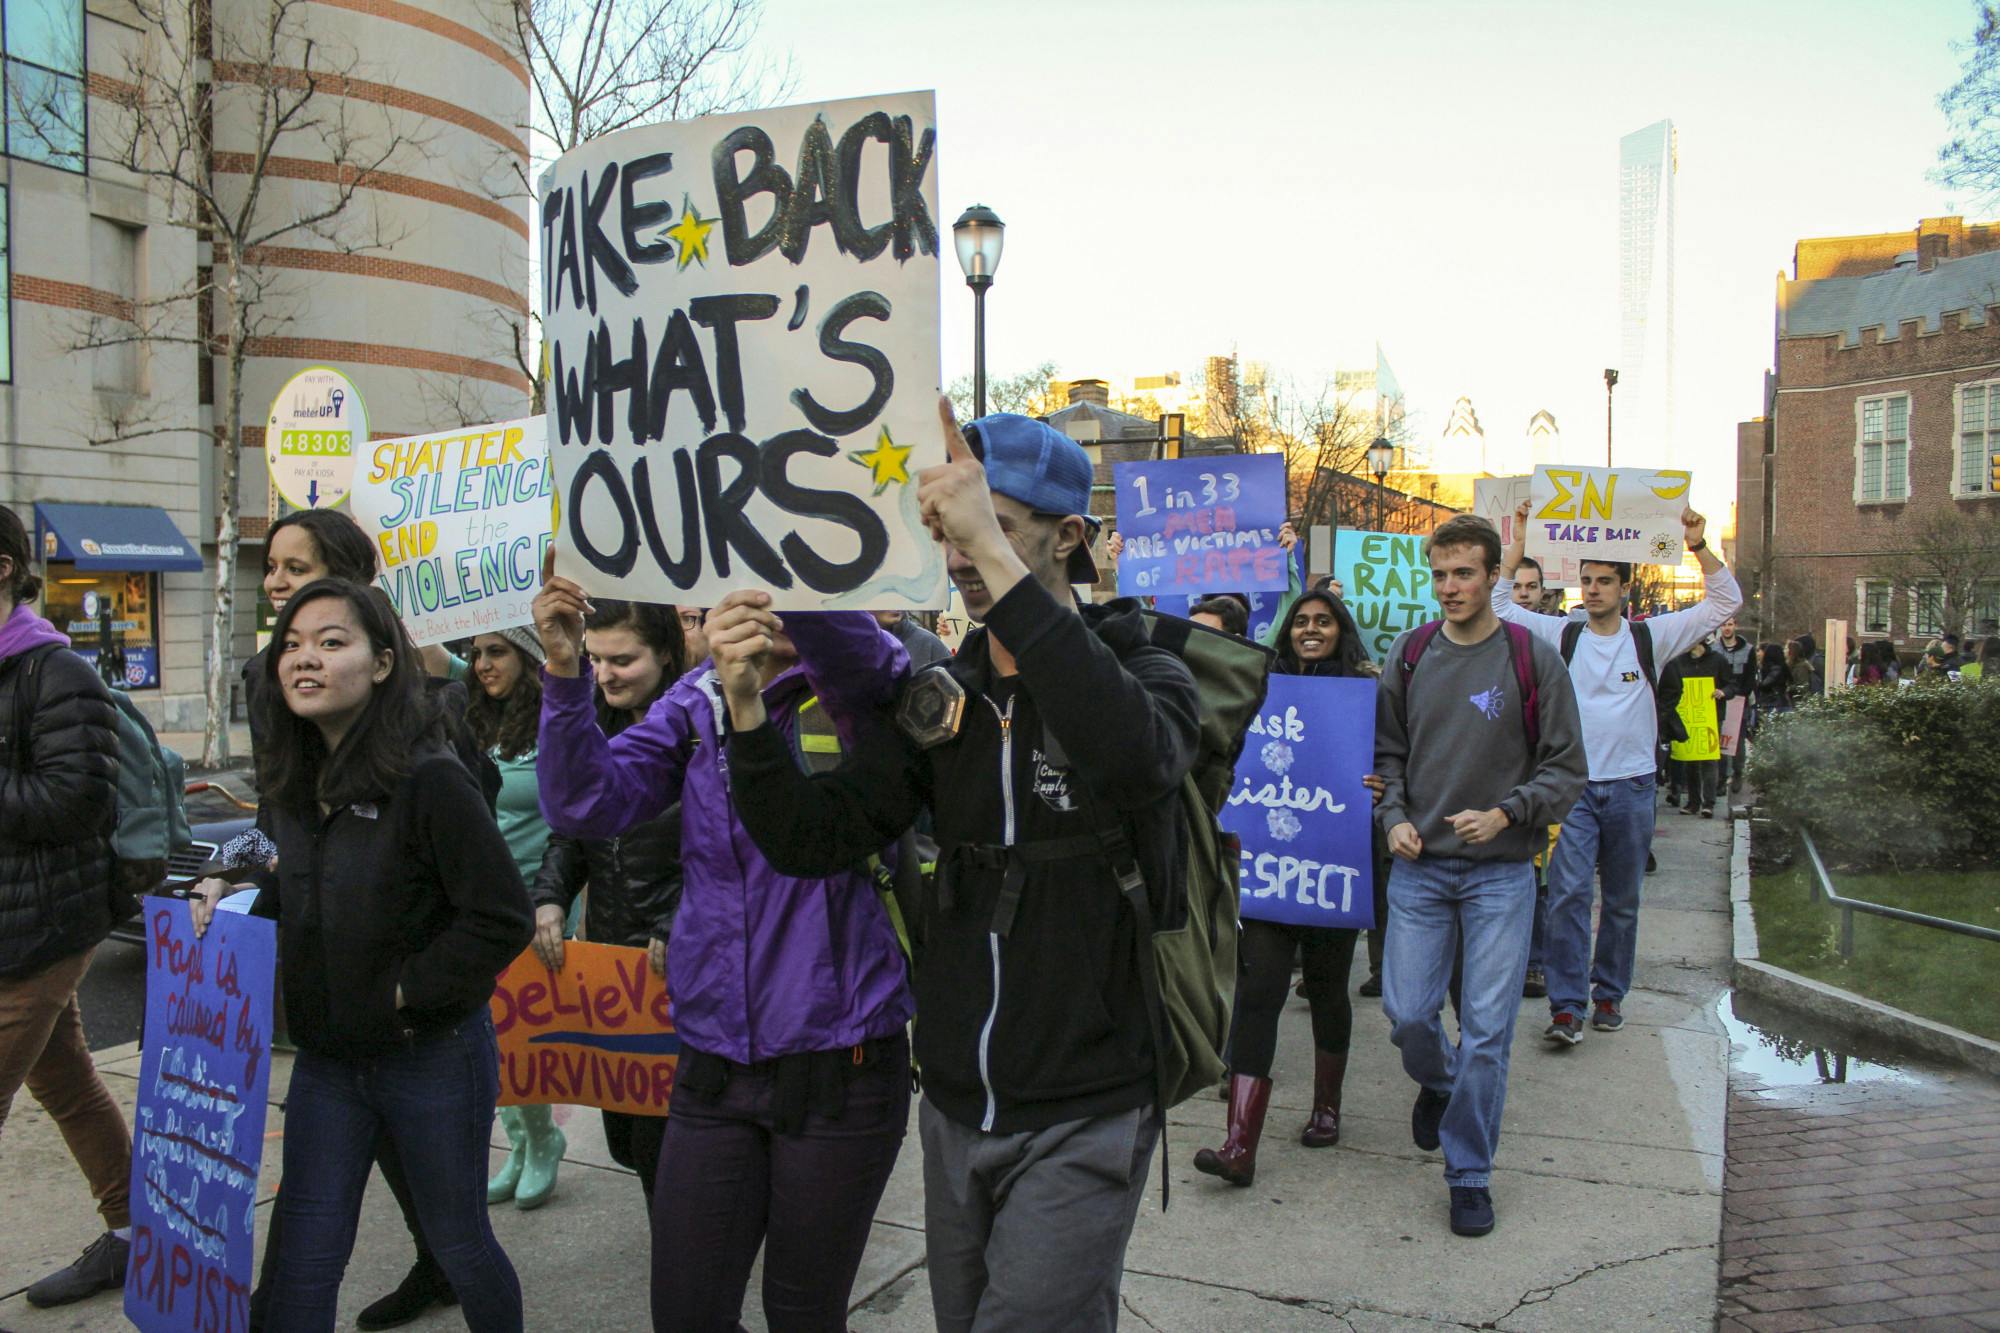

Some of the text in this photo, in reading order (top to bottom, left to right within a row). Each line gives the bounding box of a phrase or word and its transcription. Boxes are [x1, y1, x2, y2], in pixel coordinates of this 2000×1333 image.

[543, 111, 940, 317] TAKE BACK
[304, 375, 334, 385] PAY WITH
[553, 284, 895, 446] WHAT'S
[282, 432, 351, 453] 48303
[367, 426, 525, 485] SHATTER
[568, 427, 890, 594] OURS
[1133, 472, 1240, 519] 1 in 33
[377, 515, 509, 568] END the
[1125, 528, 1275, 560] ARE VICTIMS
[1164, 506, 1237, 539] MEN
[1543, 523, 1600, 543] TAKE
[1136, 547, 1281, 588] OF RAPE
[1353, 562, 1438, 600] RAP
[1239, 850, 1360, 913] ESPECT
[235, 993, 263, 1093] by
